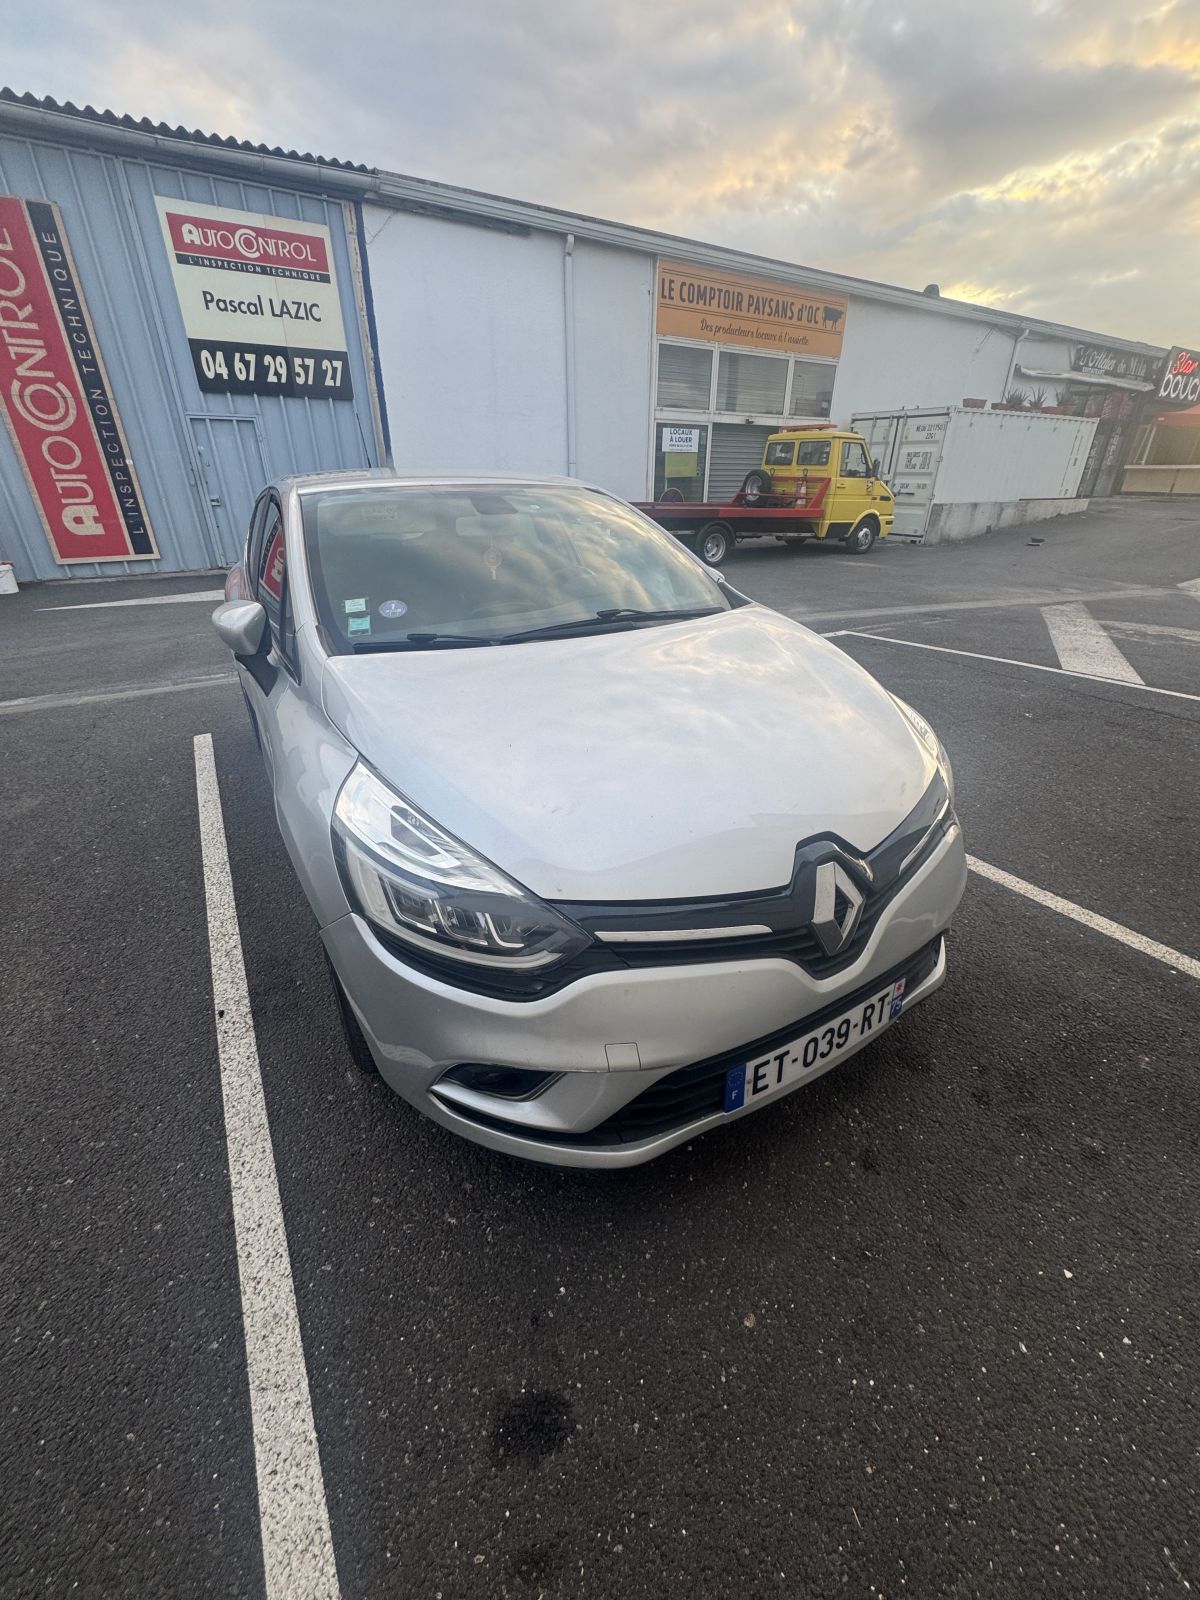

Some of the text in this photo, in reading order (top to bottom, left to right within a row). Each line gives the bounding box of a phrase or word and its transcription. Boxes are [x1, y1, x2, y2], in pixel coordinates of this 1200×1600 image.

[181, 223, 317, 262] AUTOCONTROL
[189, 256, 321, 281] L'INSPECTION TECHNIQUE
[202, 290, 322, 322] Pascal LAZIC
[661, 277, 820, 325] LE COMPTOIR PAYSANS d'OC
[700, 318, 713, 332] Des
[713, 321, 755, 339] producteurs
[755, 327, 778, 343] locaux
[200, 349, 343, 387] 04 67 29 57 27
[1171, 352, 1198, 375] Star
[42, 231, 144, 534] L'INSPECTION TECHNIQUE
[891, 998, 902, 1014] 75
[752, 992, 890, 1096] ET-039-RT
[731, 1088, 737, 1100] F
